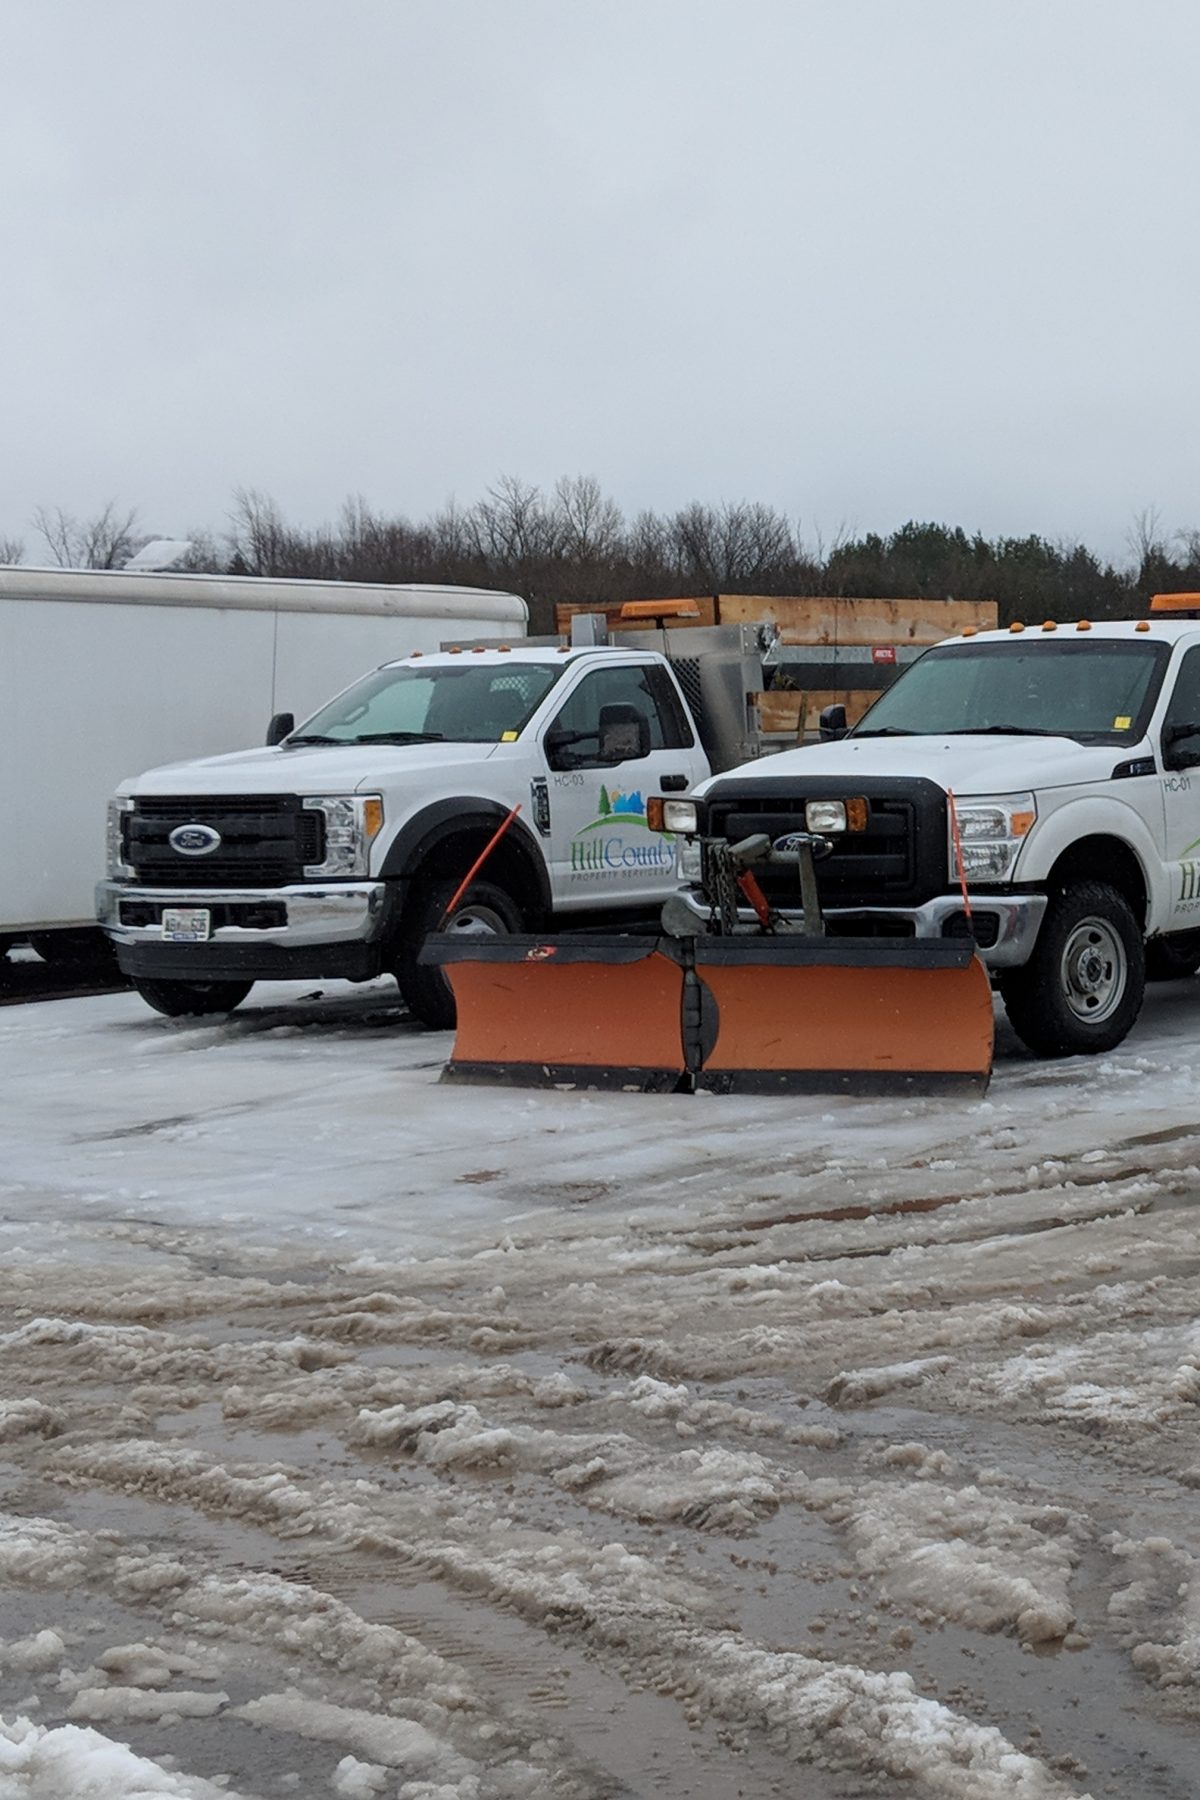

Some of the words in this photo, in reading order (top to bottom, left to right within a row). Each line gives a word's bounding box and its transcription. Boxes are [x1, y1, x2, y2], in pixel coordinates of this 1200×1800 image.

[554, 774, 585, 787] HC-03
[1164, 777, 1192, 792] HC-01
[571, 871, 618, 882] PROPERTY
